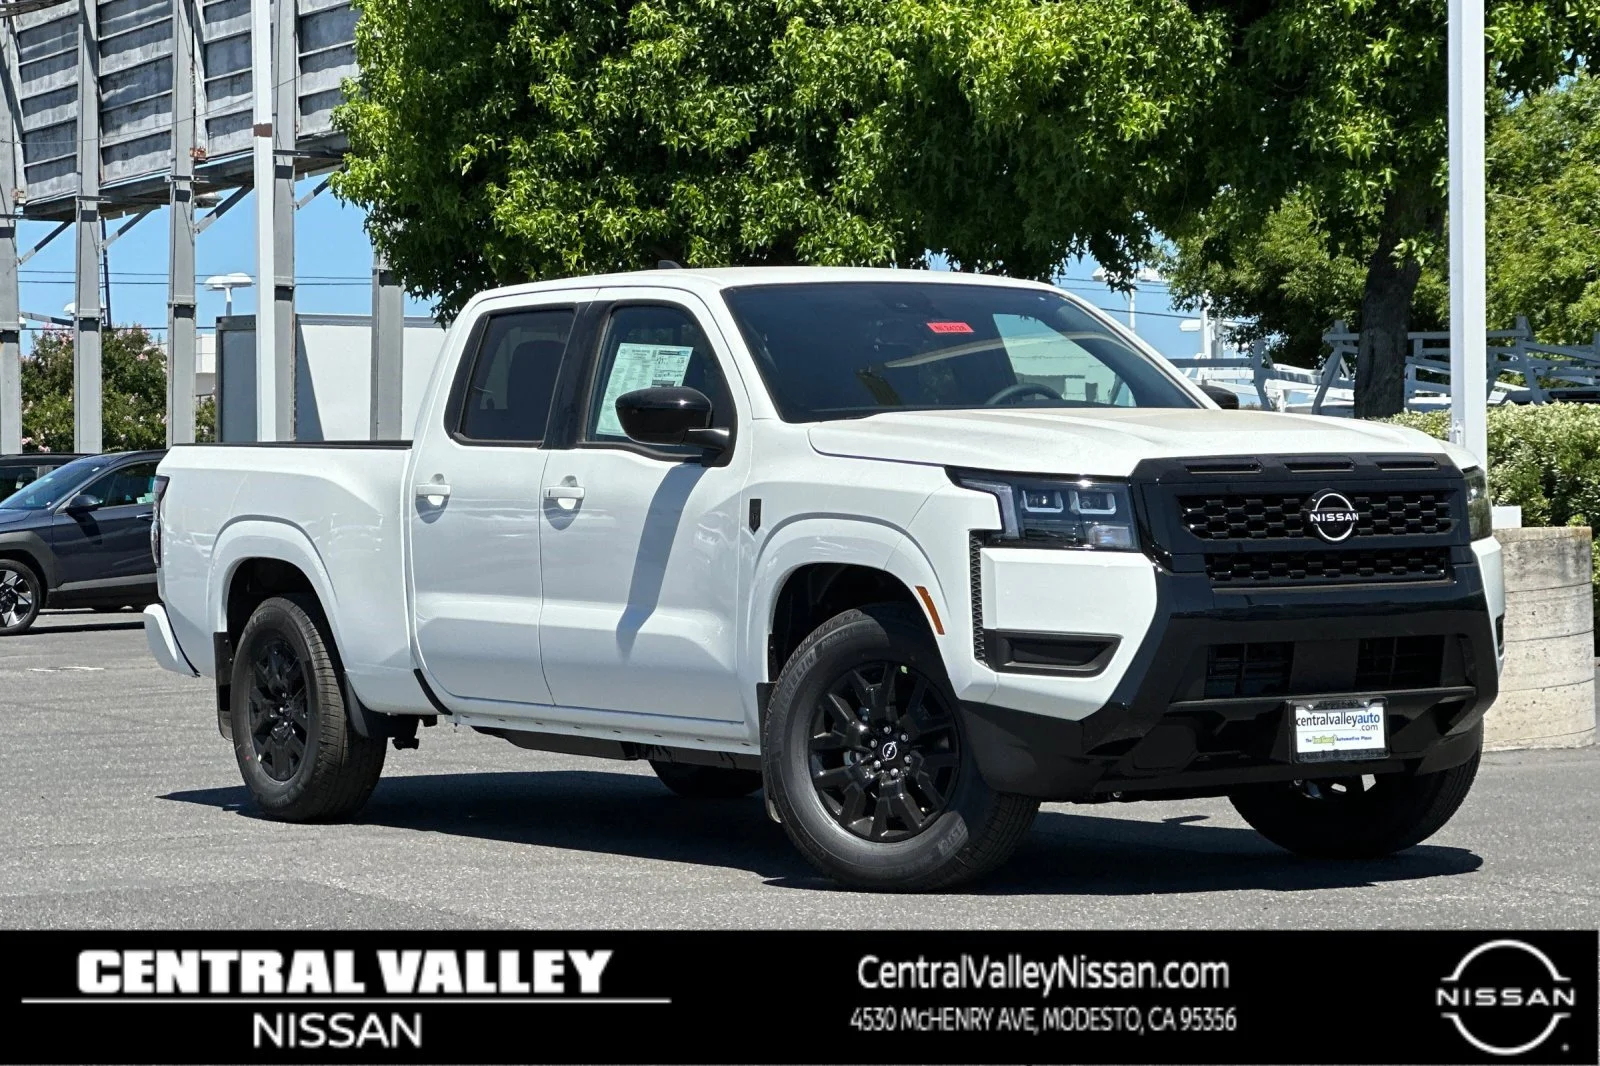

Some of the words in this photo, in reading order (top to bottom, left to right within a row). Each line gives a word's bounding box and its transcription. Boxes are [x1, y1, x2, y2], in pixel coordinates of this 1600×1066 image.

[1309, 513, 1359, 522] NISSAN
[1296, 711, 1380, 727] centralvalleyauto
[1359, 724, 1379, 732] .com
